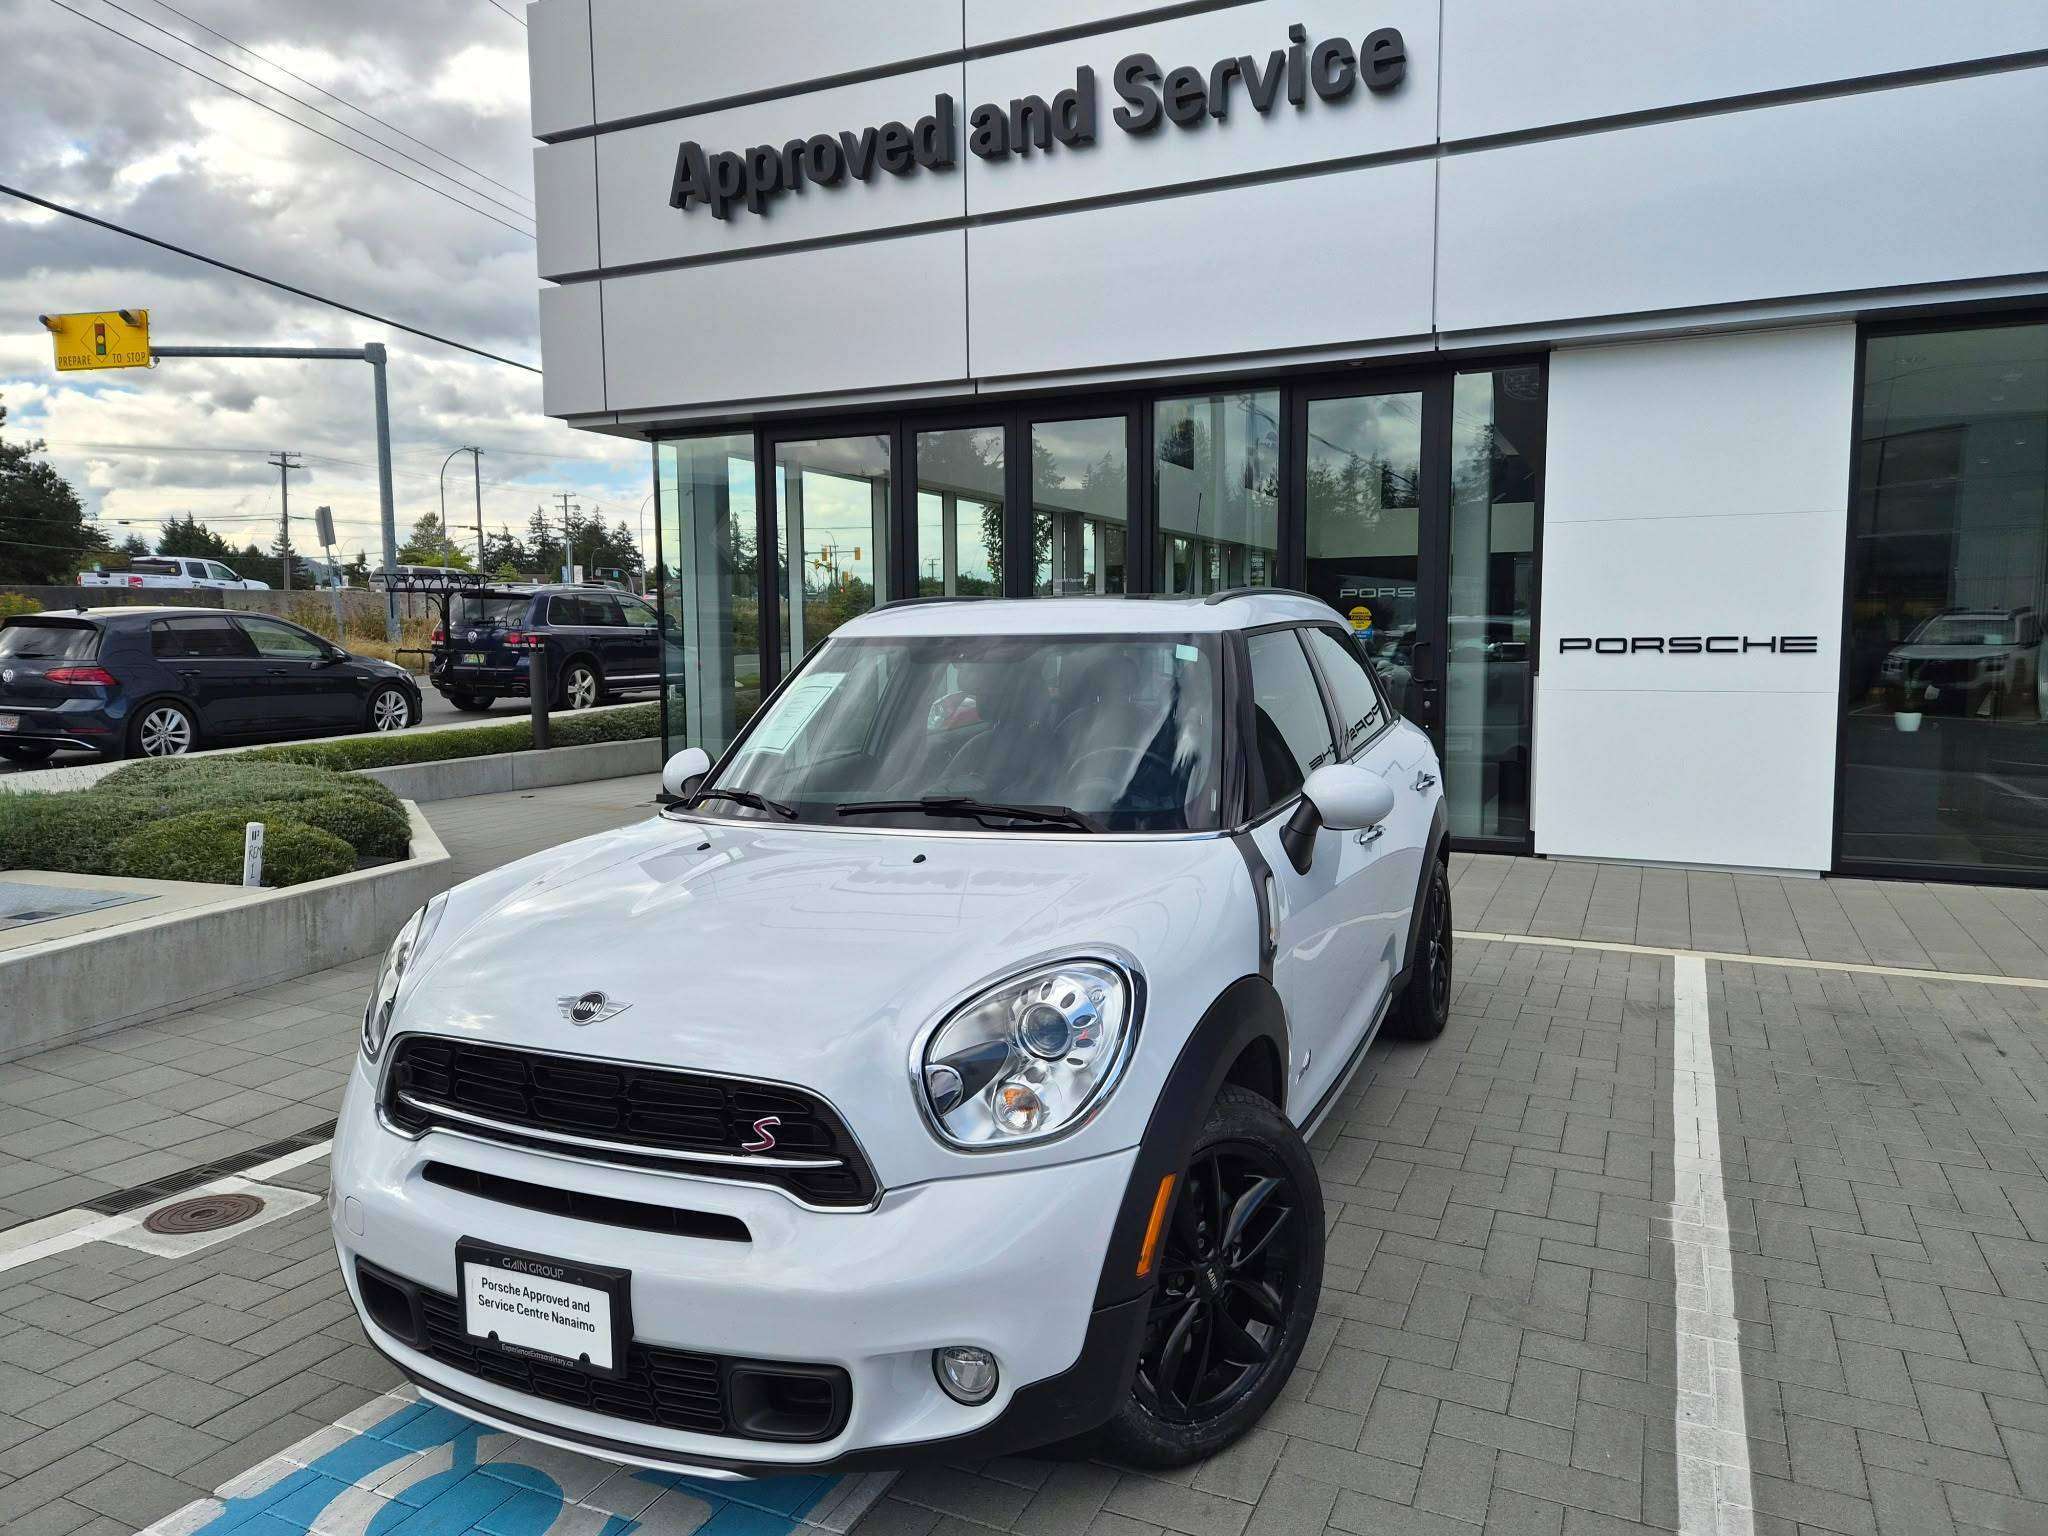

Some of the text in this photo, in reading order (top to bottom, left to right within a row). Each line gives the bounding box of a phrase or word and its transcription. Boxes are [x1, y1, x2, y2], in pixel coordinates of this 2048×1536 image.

[669, 23, 1407, 219] Approved and Service
[58, 352, 146, 367] PREPARE TO STOP
[1340, 587, 1416, 599] PORS
[1559, 636, 1818, 654] PORSCHE
[574, 1001, 601, 1012] MINI
[742, 1116, 781, 1152] S
[502, 1257, 564, 1279] GAIN GROUP
[481, 1277, 590, 1313] Porsche Approved and
[478, 1294, 595, 1333] Service Centre Nanaimo
